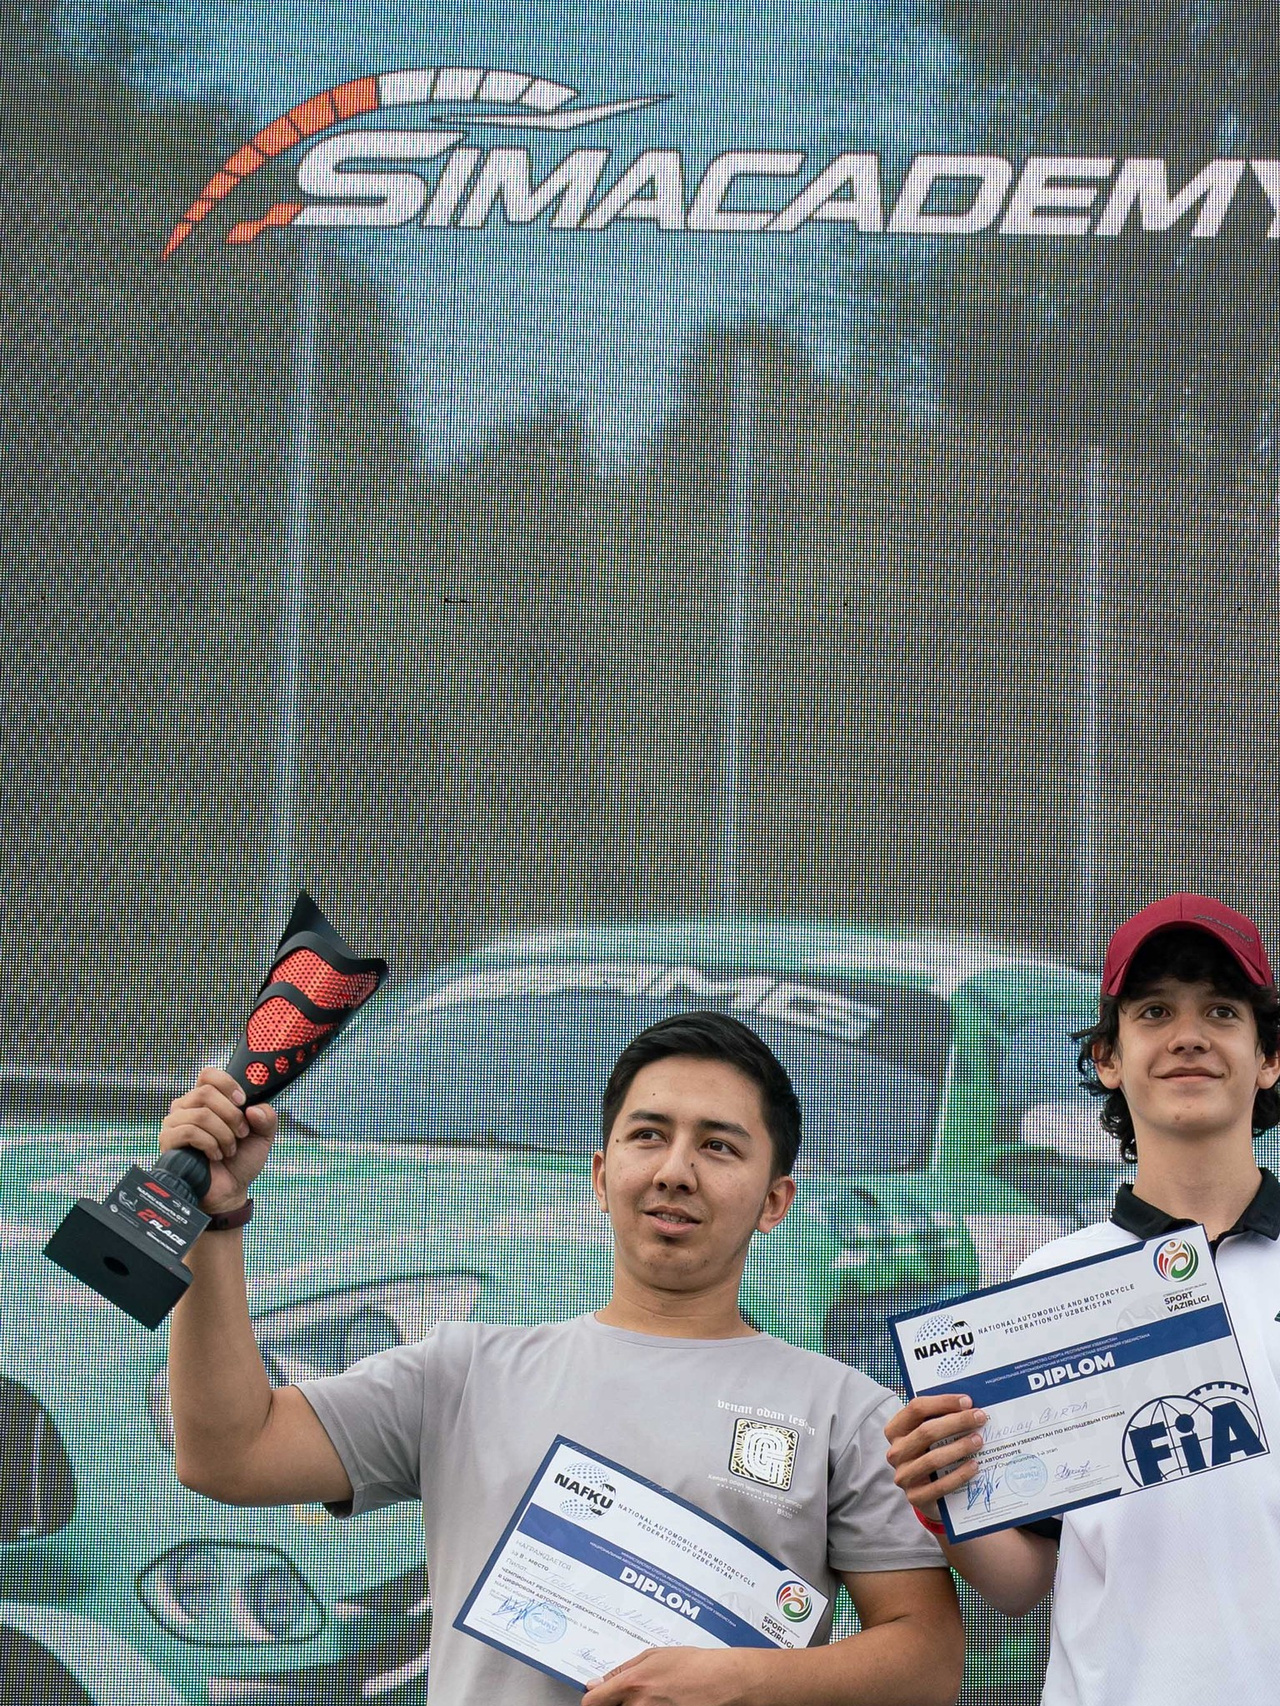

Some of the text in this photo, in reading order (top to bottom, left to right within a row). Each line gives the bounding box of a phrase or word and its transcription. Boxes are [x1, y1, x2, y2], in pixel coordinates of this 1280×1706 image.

[148, 1219, 187, 1247] PLACE
[977, 1283, 1135, 1335] NATIONAL AUTOMOBILE AND MOTORCYCLE
[1004, 1297, 1112, 1335] FEDERATION OF UZBEKISTAN
[1163, 1290, 1194, 1305] SPORT
[1166, 1293, 1210, 1313] VAZIRLIGI
[913, 1331, 976, 1361] NAFKU
[1026, 1350, 1116, 1391] DIPLOM
[977, 1441, 1016, 1457] РЕСПУБЛИКИ
[1015, 1430, 1054, 1445] УЗБЕКИСТАН
[1053, 1427, 1063, 1435] ПО
[1063, 1417, 1101, 1432] КОЛЬЦЕВЫМ
[1100, 1409, 1125, 1421] ГОНКАМ
[983, 1448, 1022, 1463] АВТОСПОРТЕ
[552, 1471, 613, 1511] NAFKU
[616, 1502, 759, 1588] NATIONAL AUTOMOBILE AND MOTORCYCLE
[635, 1520, 735, 1580] FEDERATION OF UZBEKISTAN
[499, 1564, 536, 1588] ЧЕМПИОНАТ
[534, 1582, 572, 1606] РЕСПУБЛИКИ
[605, 1618, 616, 1627] ПО
[501, 1573, 536, 1597] ЦИФРОВОМ
[534, 1590, 571, 1614] АВТОСПОРТЕ
[618, 1565, 702, 1621] DIPLOM
[757, 1621, 798, 1650] VAZIRLIGI
[760, 1614, 789, 1636] SPORT
